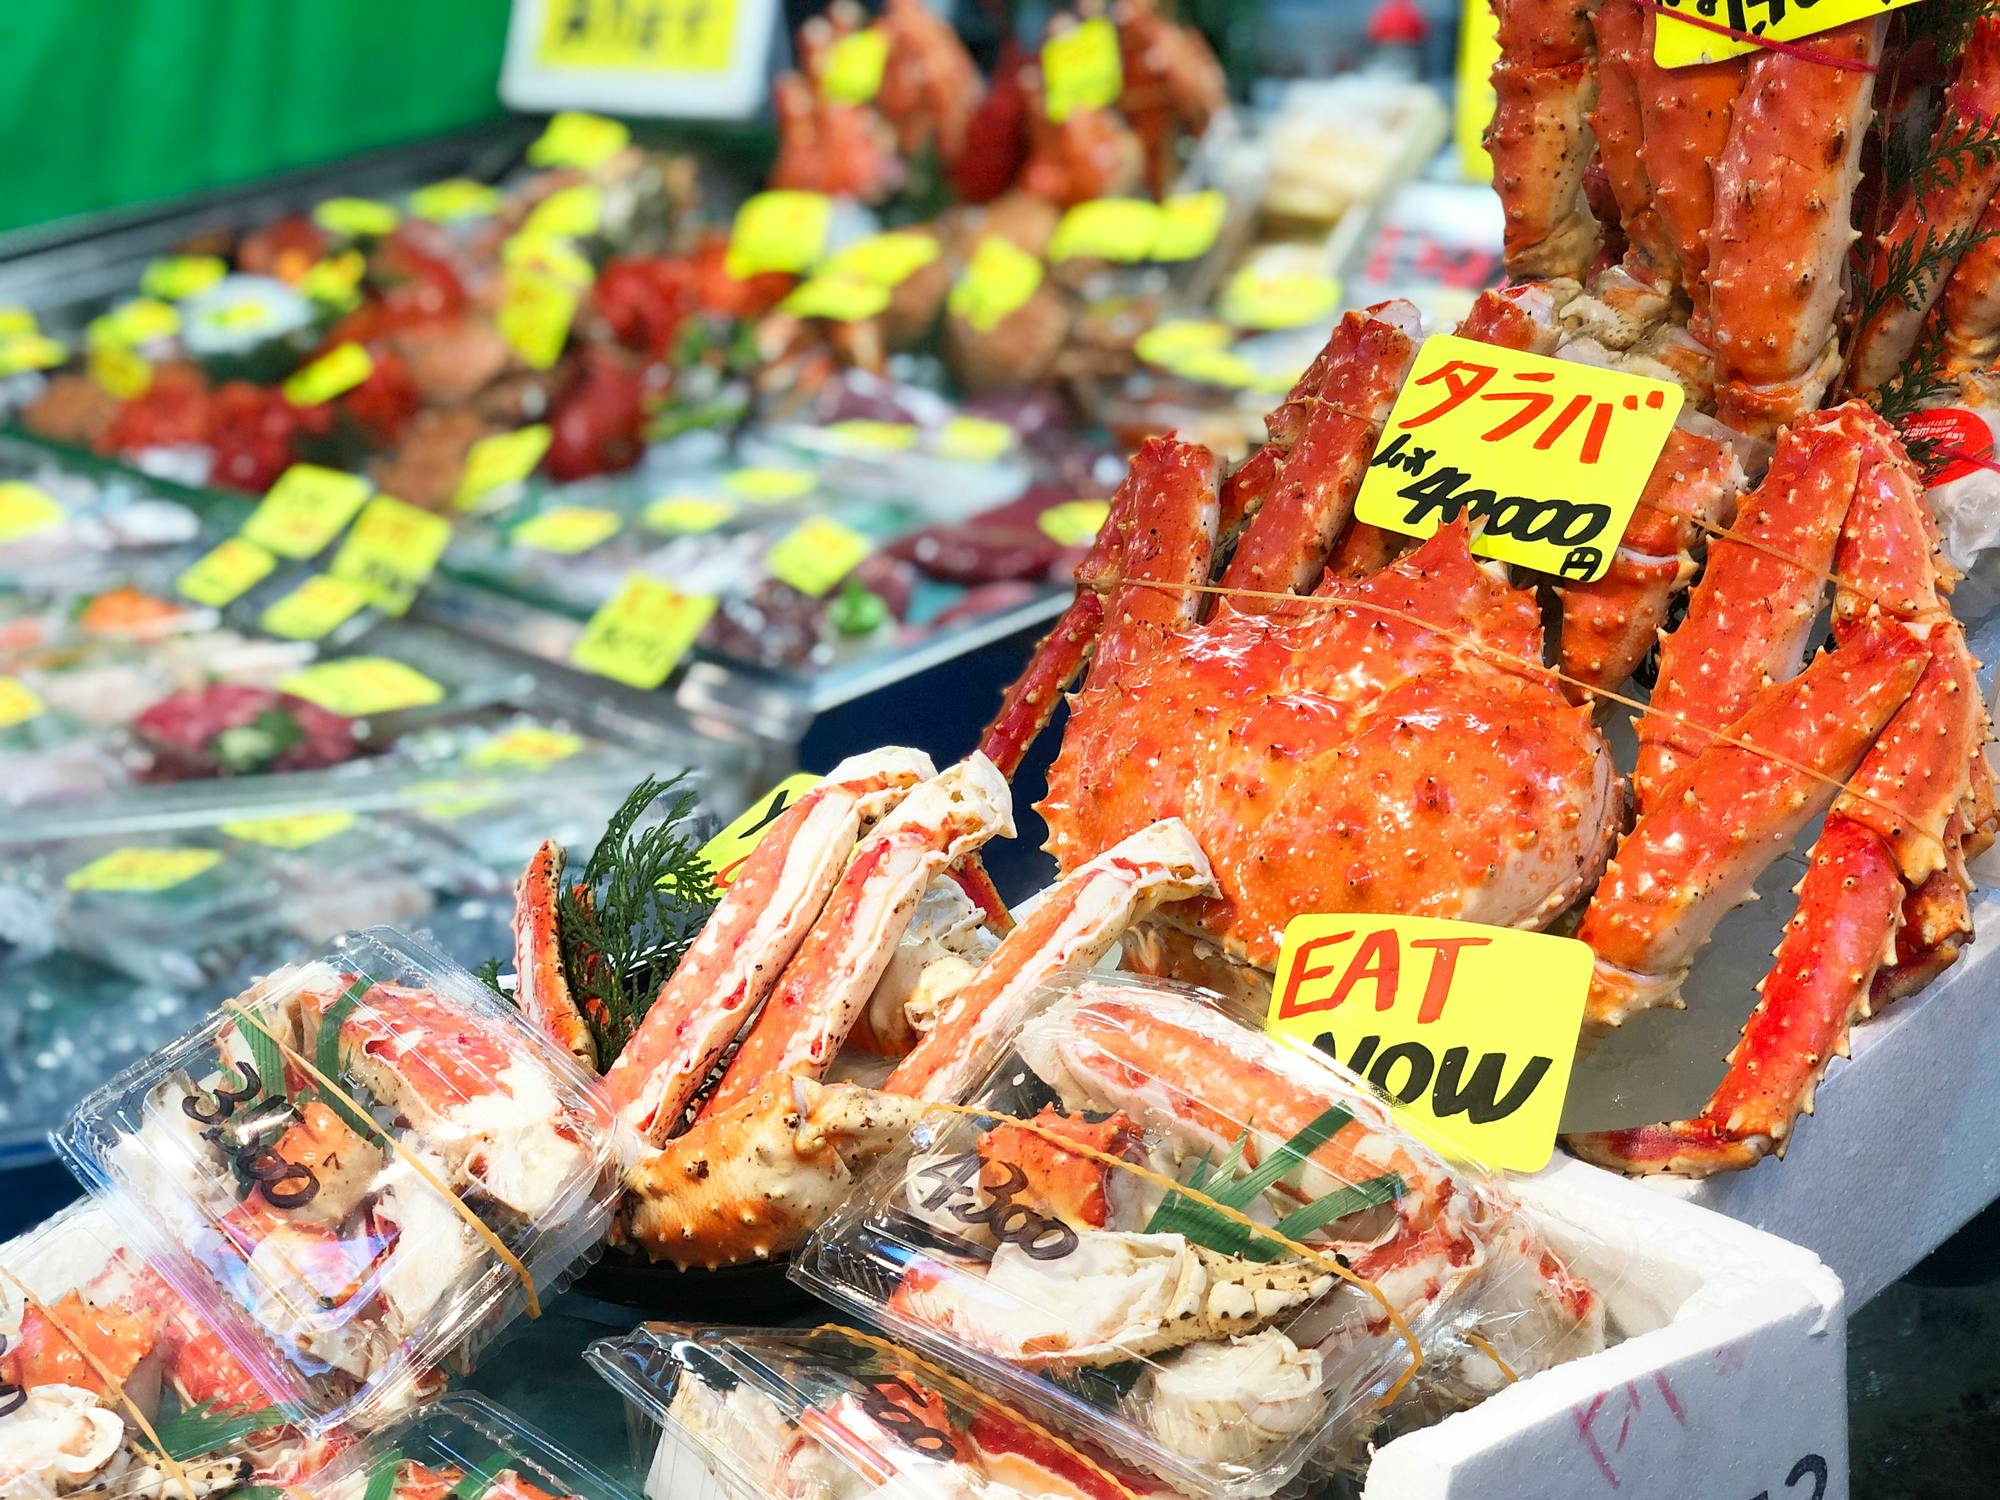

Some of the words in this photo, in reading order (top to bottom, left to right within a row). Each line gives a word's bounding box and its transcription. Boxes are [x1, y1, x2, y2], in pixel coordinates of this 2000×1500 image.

[1398, 361, 1664, 464] タラバ
[1279, 928, 1493, 1024] EAT
